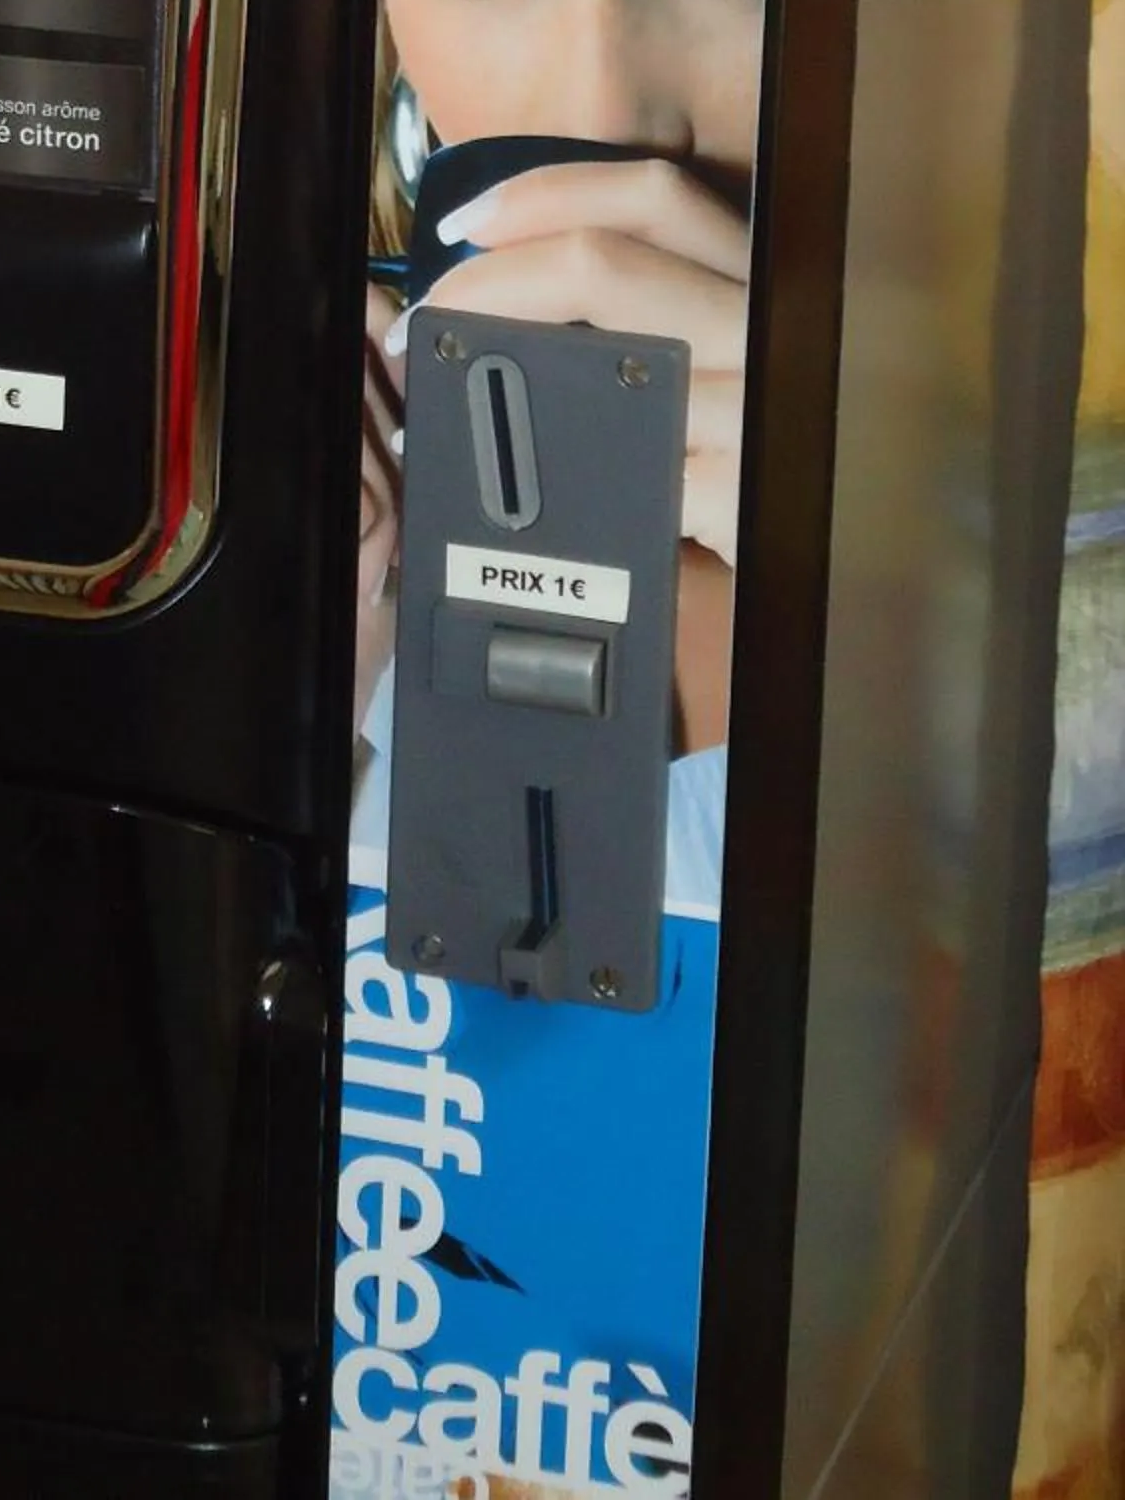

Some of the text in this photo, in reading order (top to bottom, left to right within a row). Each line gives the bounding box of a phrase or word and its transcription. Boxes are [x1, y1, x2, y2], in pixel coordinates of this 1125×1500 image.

[42, 101, 101, 121] arôme
[19, 125, 101, 151] citron
[481, 565, 544, 594] PRIX
[332, 1347, 691, 1496] caffè
